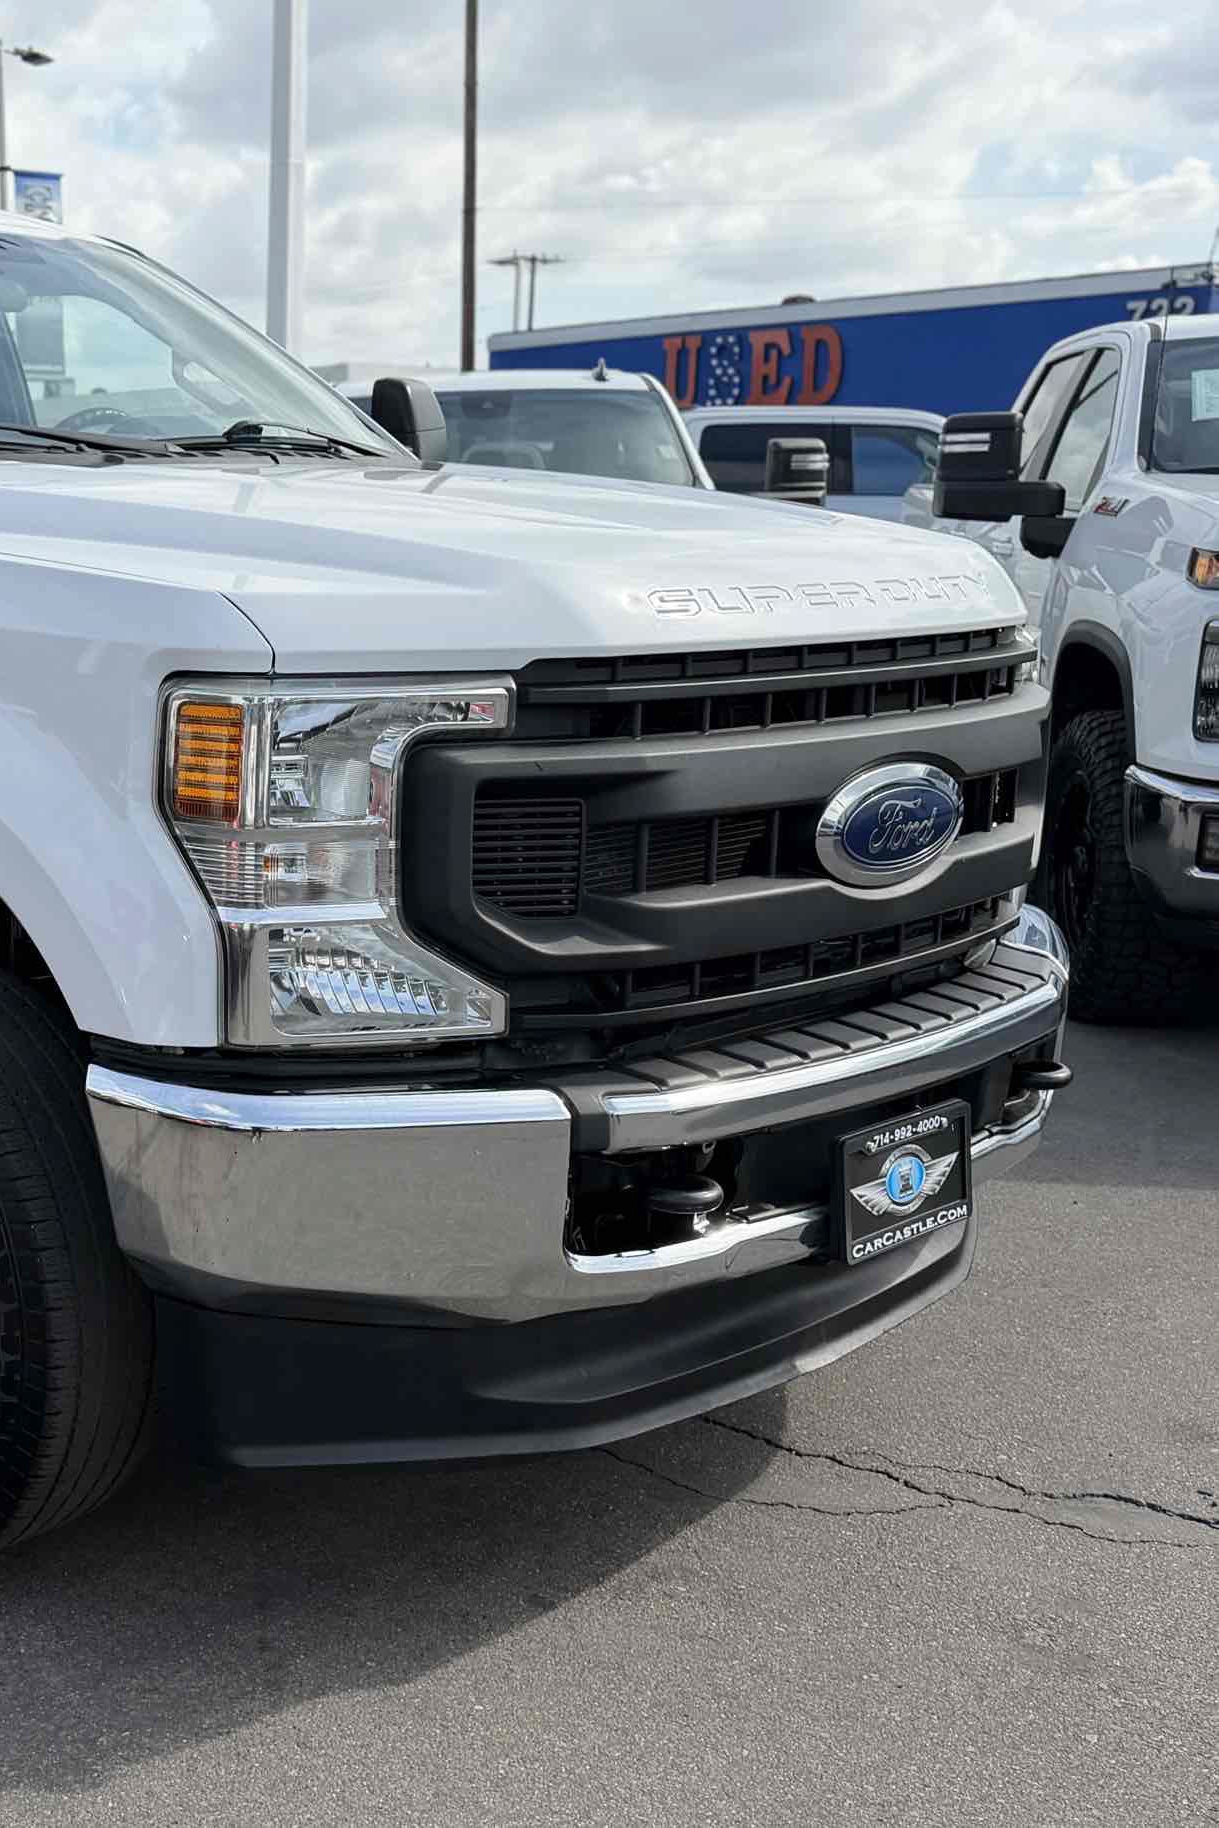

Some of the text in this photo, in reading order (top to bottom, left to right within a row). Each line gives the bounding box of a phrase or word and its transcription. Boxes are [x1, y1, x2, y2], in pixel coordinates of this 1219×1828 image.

[663, 324, 843, 409] USED
[646, 571, 987, 617] SUPER DUTY
[868, 797, 938, 854] Ford
